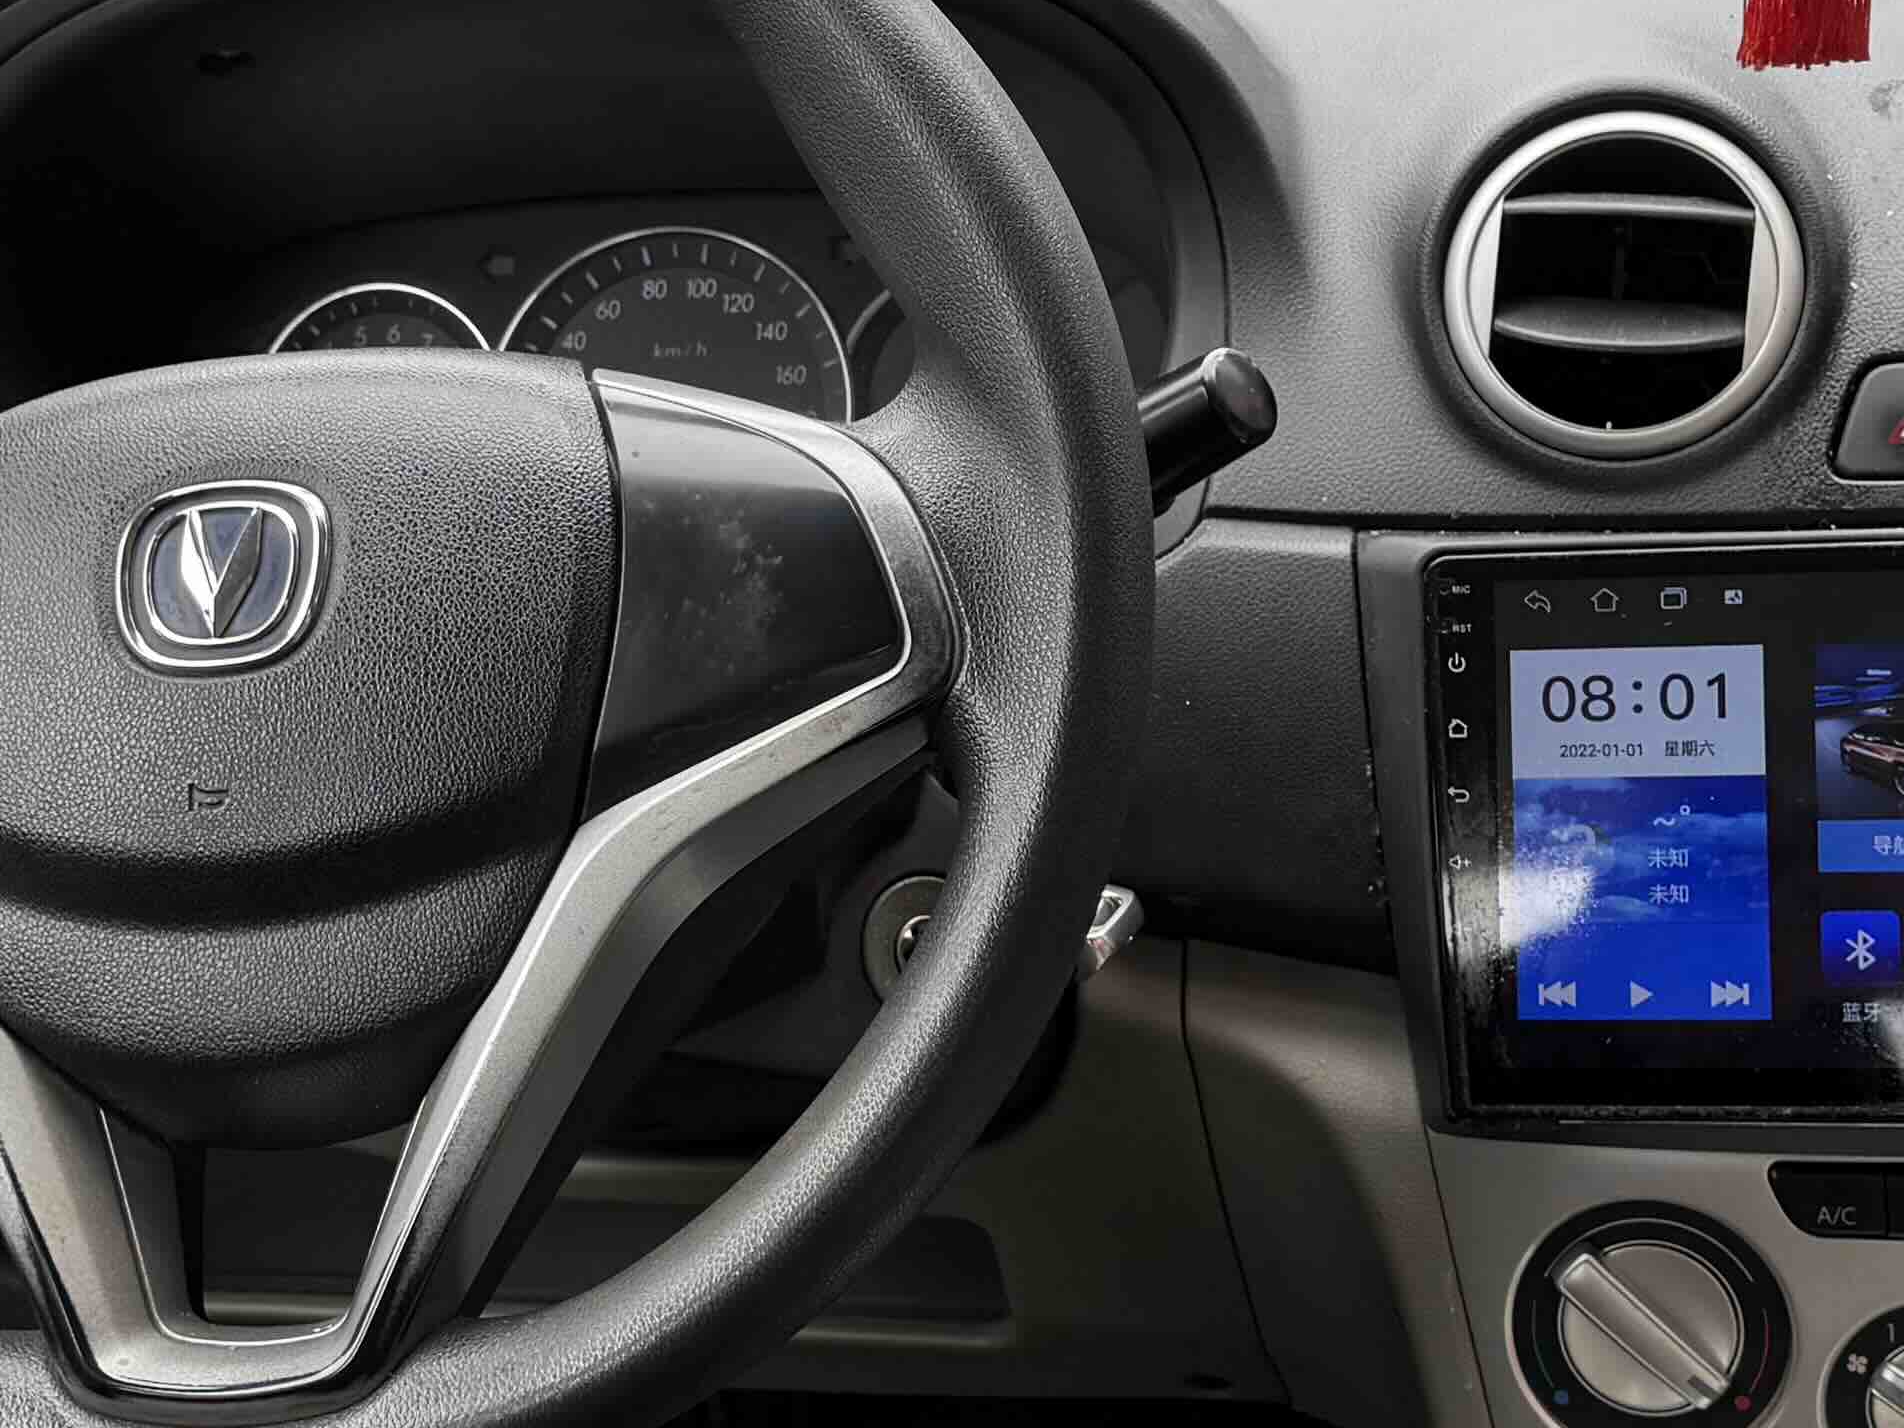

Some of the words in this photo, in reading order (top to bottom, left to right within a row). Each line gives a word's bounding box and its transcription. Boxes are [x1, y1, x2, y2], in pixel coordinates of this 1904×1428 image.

[642, 279, 667, 300] 80
[687, 278, 717, 299] 100
[596, 300, 621, 320] 60
[723, 293, 754, 314] 120
[353, 326, 368, 347] 5
[386, 323, 401, 344] 6
[561, 331, 587, 351] 40
[756, 322, 788, 341] 140
[776, 365, 807, 386] 160
[1451, 585, 1471, 594] MIC
[1451, 623, 1472, 633] RST
[1542, 672, 1728, 723] 08:01
[1559, 742, 1644, 759] 2022-01-01
[1664, 739, 1716, 758] 星期六
[1647, 848, 1689, 870] 未知
[1647, 884, 1689, 905] 未知
[1842, 1002, 1881, 1022] 蓝牙
[1817, 1206, 1857, 1226] A/C
[1887, 1323, 1895, 1343] 1
